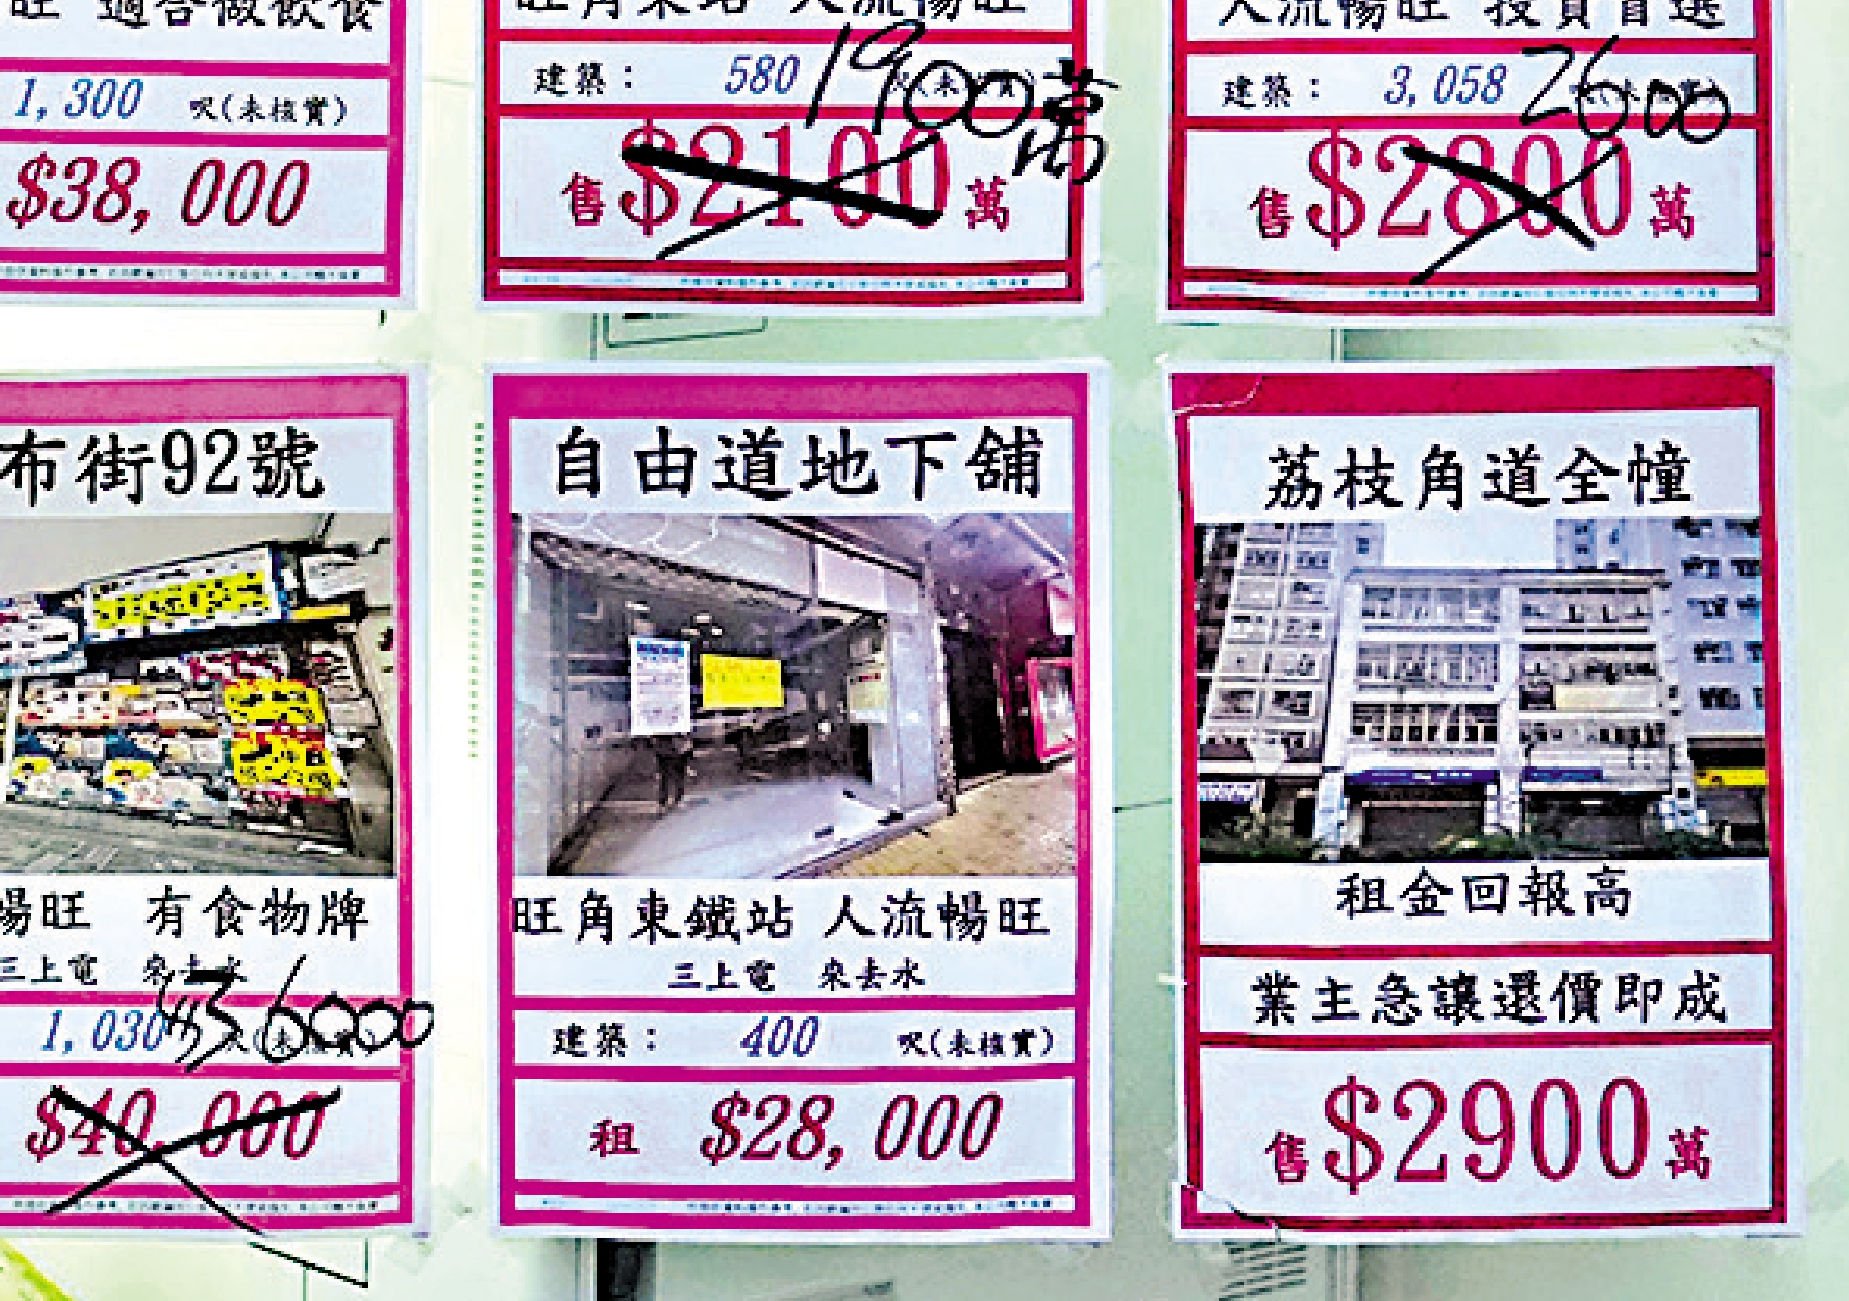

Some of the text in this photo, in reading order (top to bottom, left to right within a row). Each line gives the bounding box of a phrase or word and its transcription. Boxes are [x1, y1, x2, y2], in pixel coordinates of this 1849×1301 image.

[14, 77, 143, 123] 1,300
[724, 56, 800, 95] 580
[1384, 65, 1509, 108] 3,058
[5, 152, 312, 232] $38,000
[554, 424, 1044, 501] 自由道地下舖
[1264, 441, 1693, 512] 荔枝角道全幢
[144, 889, 370, 942] 有食物牌
[1337, 864, 1633, 919] 租金回報高
[512, 892, 1050, 947] 旺角東鐵站 人流暢旺
[1250, 971, 1728, 1026] 業主急讓還價即成
[739, 1016, 819, 1058] 400
[590, 1091, 1003, 1170] 租 $28,000
